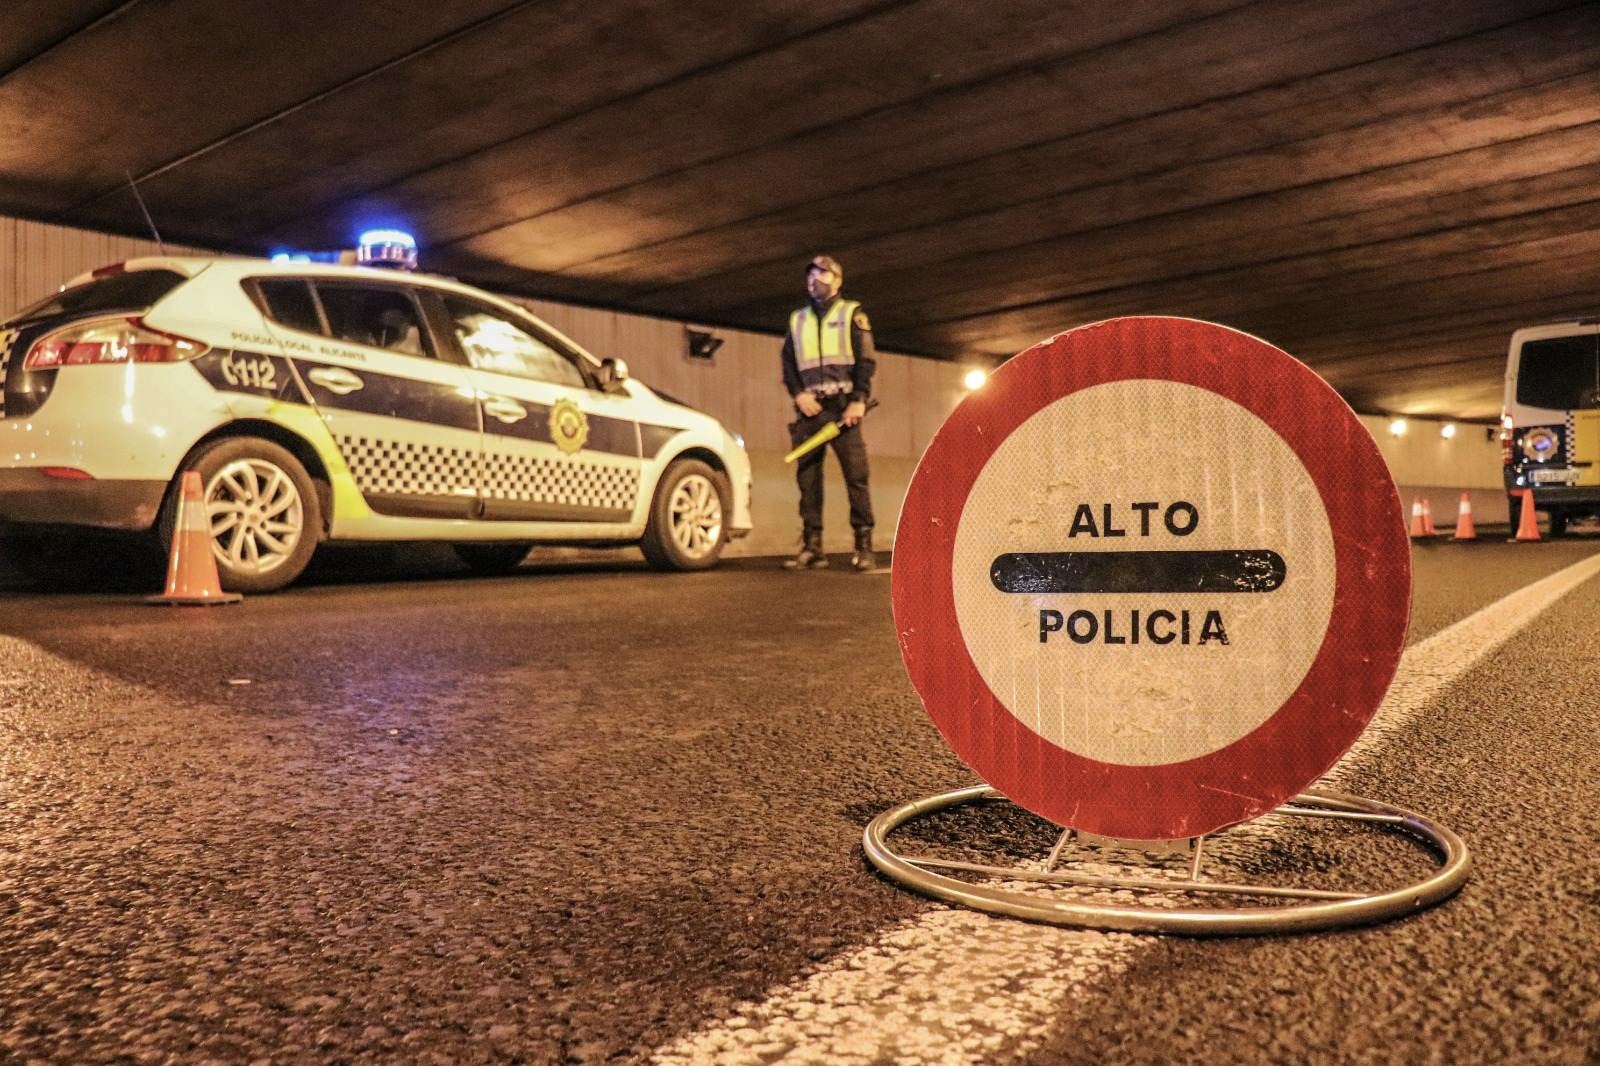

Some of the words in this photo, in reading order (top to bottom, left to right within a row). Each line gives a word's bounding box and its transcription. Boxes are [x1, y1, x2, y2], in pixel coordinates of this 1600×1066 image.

[234, 358, 277, 389] 112
[1067, 501, 1199, 538] ALTO
[1039, 609, 1230, 645] POLICIA
